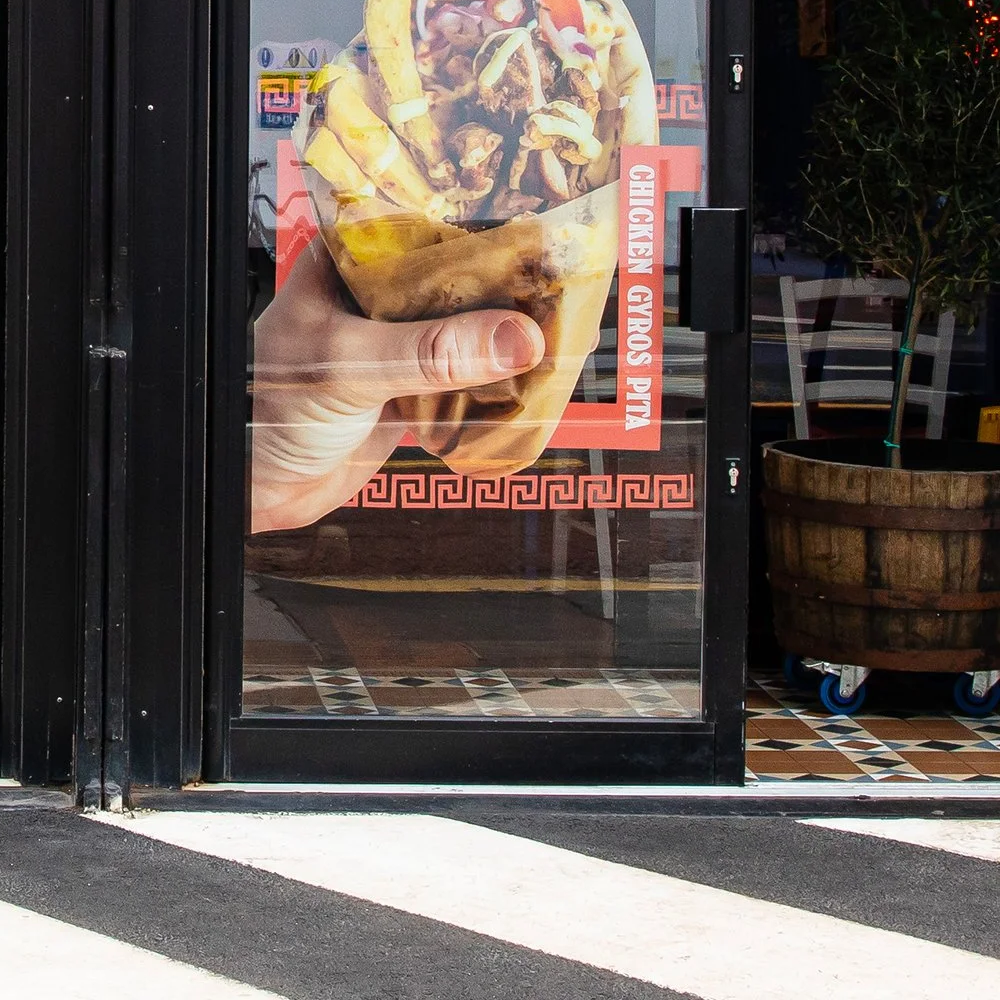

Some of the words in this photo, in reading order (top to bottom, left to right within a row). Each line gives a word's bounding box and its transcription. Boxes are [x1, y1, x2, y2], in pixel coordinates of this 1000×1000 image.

[627, 164, 655, 274] CHICKEN
[626, 284, 653, 366] GYROS
[625, 377, 652, 431] PITA
